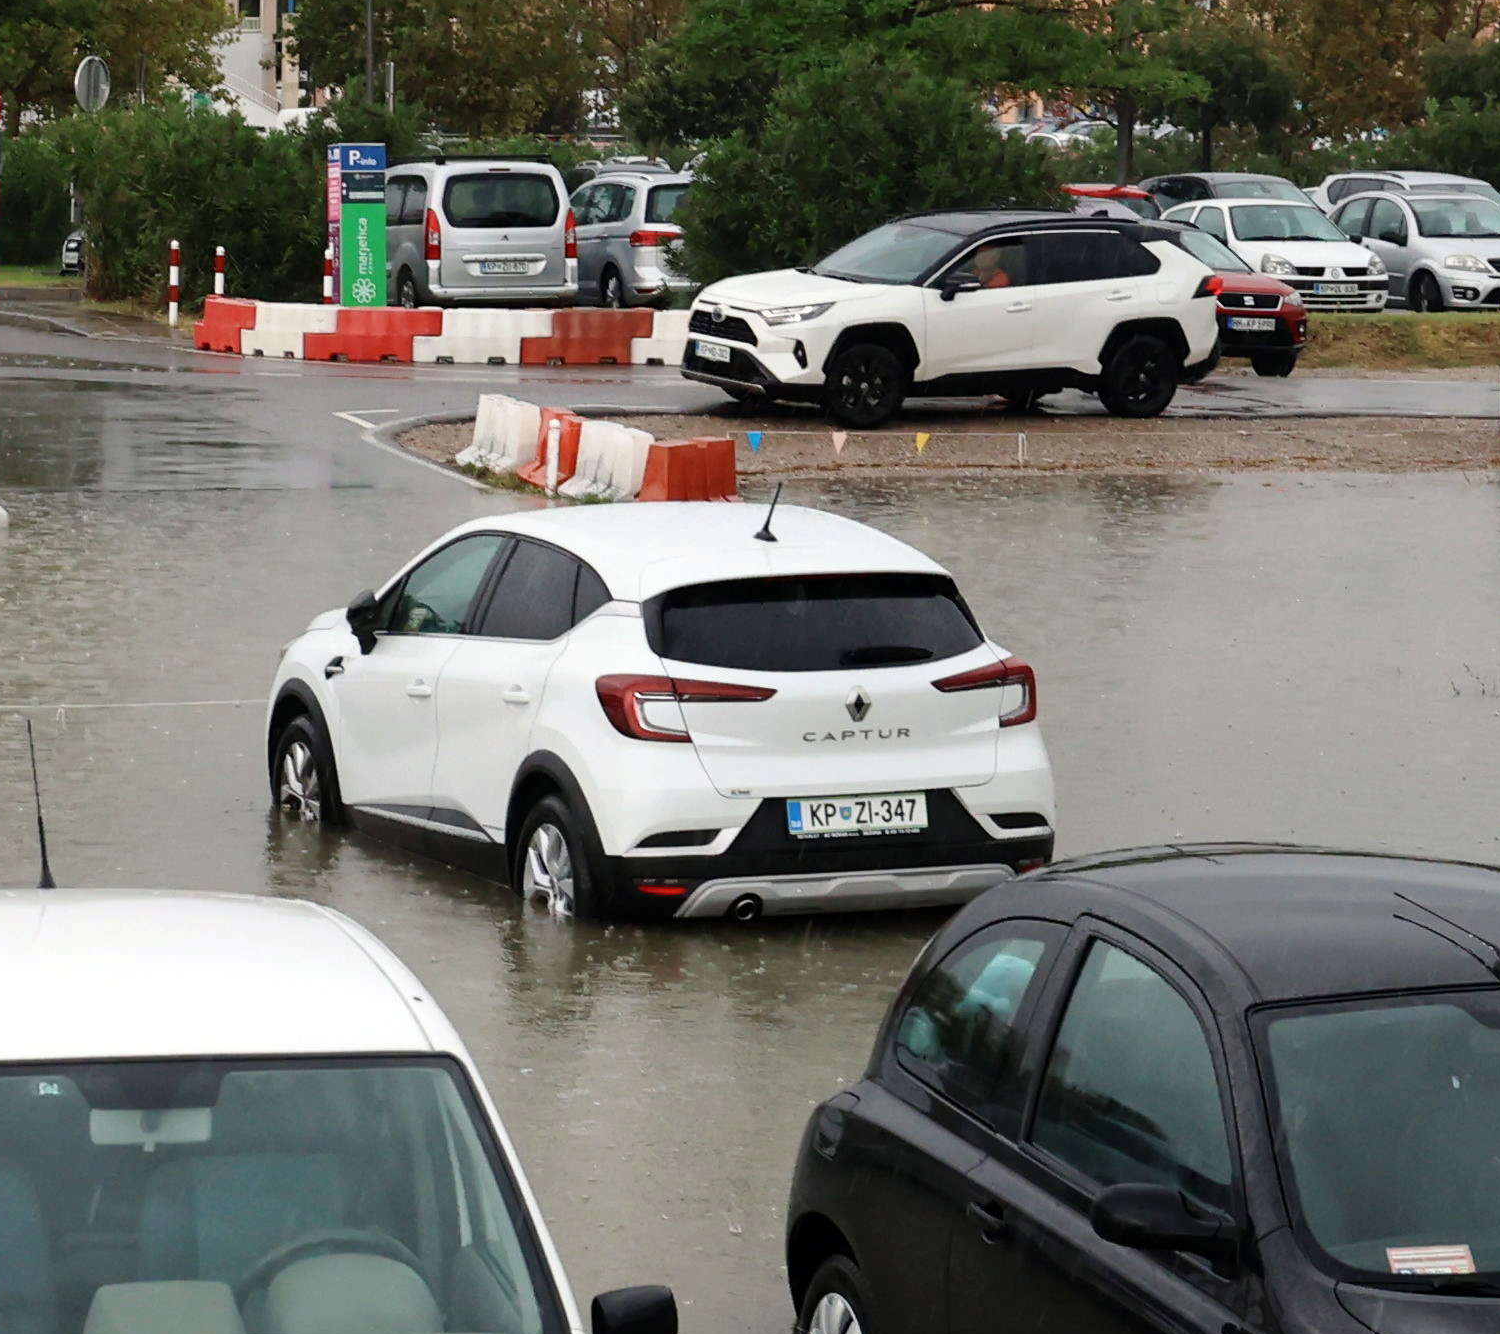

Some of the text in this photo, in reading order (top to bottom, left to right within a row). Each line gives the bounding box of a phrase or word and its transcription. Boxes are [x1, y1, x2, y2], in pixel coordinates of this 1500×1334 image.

[348, 149, 377, 166] P-info
[356, 218, 371, 275] marjetica
[802, 727, 911, 743] CAPTUR
[809, 803, 837, 827] KP
[854, 798, 917, 824] ZI-347
